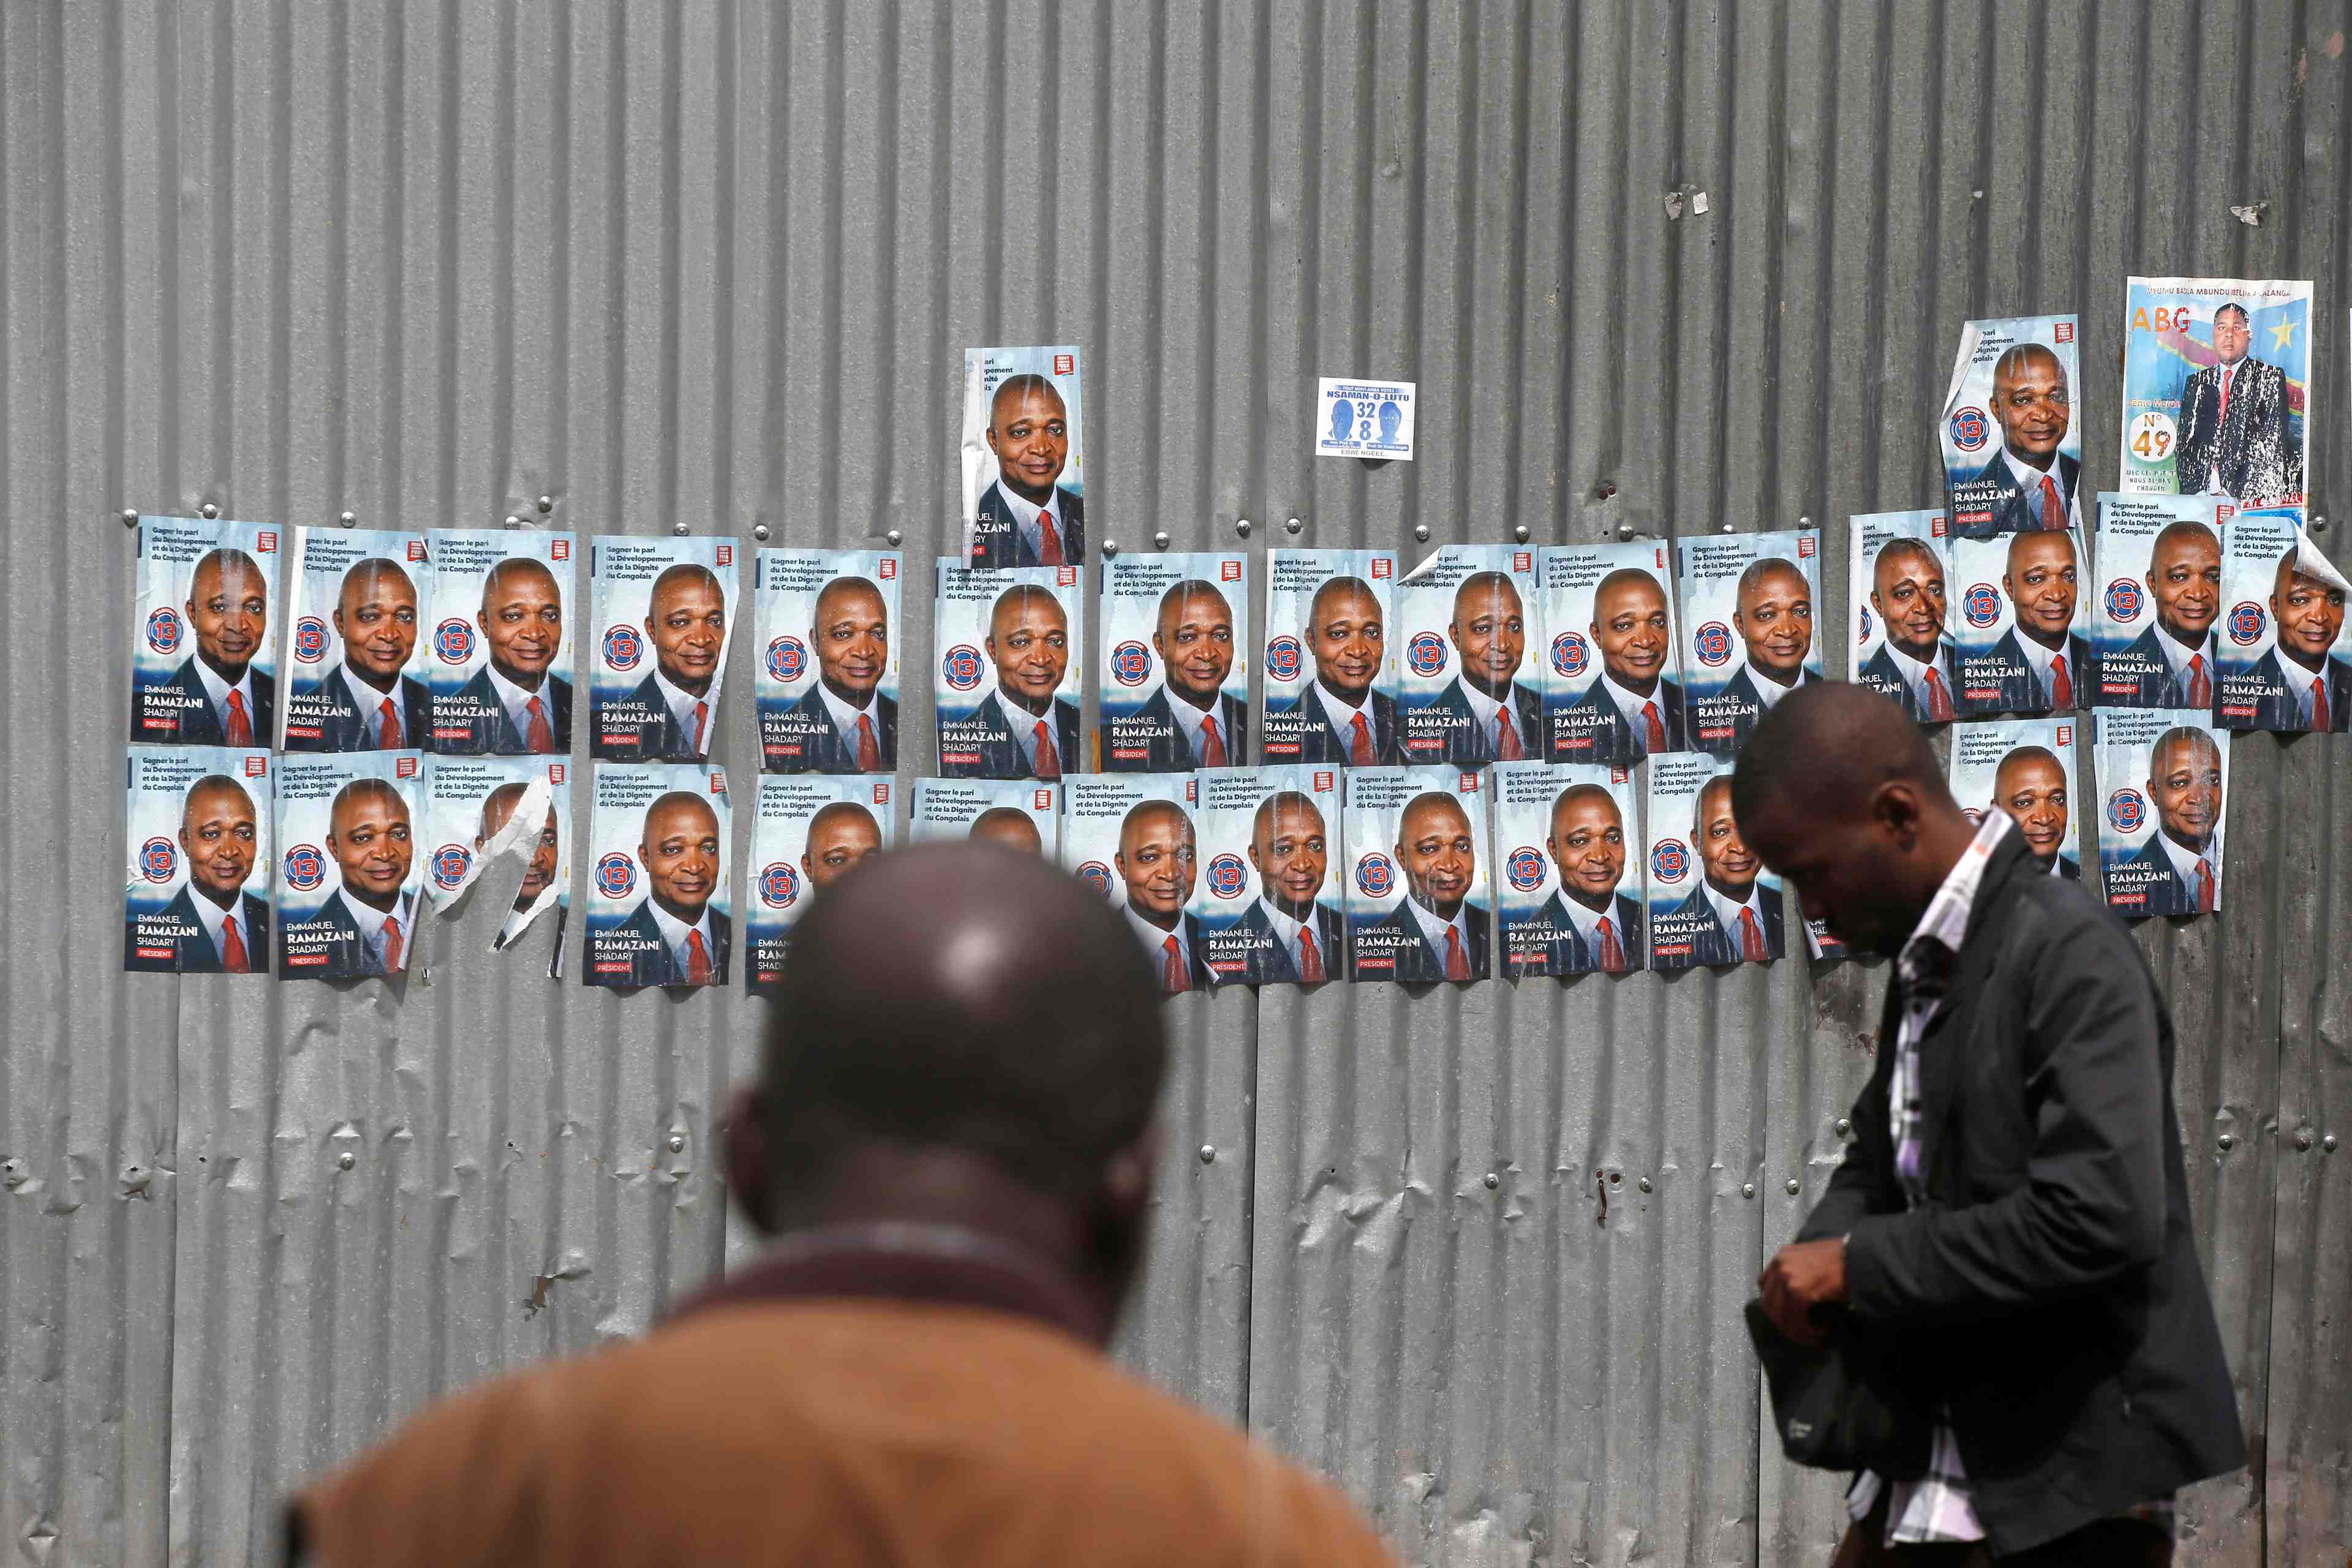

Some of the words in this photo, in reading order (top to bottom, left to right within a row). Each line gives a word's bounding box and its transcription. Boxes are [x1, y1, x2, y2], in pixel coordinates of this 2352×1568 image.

[2132, 306, 2191, 333] ABG
[1327, 391, 1409, 401] NSAMAN-O-LUTU
[1357, 401, 1376, 418] 32
[2144, 415, 2162, 427] N°
[1360, 420, 1371, 440] 8
[1960, 420, 1981, 438] 13
[2133, 430, 2171, 457] 49
[1954, 480, 1997, 490] EMMANUEL
[1956, 490, 2015, 502] RAMAZANI
[1956, 503, 1991, 511] SHADARY
[2112, 502, 2136, 510] Gagner
[2120, 527, 2154, 536] Congolais
[1972, 597, 1994, 614] 13
[2114, 591, 2135, 609] 13
[2237, 615, 2258, 632] 13
[156, 622, 175, 640] 13
[298, 630, 321, 649] 13
[444, 632, 467, 650] 13
[1704, 635, 1725, 652] 13
[612, 639, 634, 657] 13
[776, 650, 798, 668] 13
[1275, 650, 1296, 667] 13
[1417, 646, 1439, 663] 13
[1560, 646, 1581, 663] 13
[2103, 652, 2147, 662] EMMANUEL
[953, 658, 975, 676] 13
[1121, 655, 1144, 672] 13
[2103, 662, 2163, 674] RAMAZANI
[1966, 668, 2024, 677] RAMAZANI
[2103, 673, 2139, 683] SHADARY
[2223, 674, 2266, 684] EMMANUEL
[145, 685, 186, 695] EMMANUEL
[2223, 684, 2283, 697] RAMAZANI
[145, 696, 202, 709] RAMAZANI
[433, 696, 480, 705] EMMANUEL
[1698, 696, 1741, 705] EMMANUEL
[2222, 696, 2258, 706] SHADARY
[433, 706, 498, 718] RAMAZANI
[602, 702, 648, 711] EMMANUEL
[1554, 707, 1598, 716] EMMANUEL
[1699, 705, 1758, 717] RAMAZANI
[144, 707, 178, 718] SHADARY
[603, 712, 666, 723] RAMAZANI
[765, 712, 811, 722] EMMANUEL
[432, 718, 472, 728] SHADARY
[1113, 717, 1158, 725] EMMANUEL
[1409, 717, 1470, 728] RAMAZANI
[1555, 715, 1616, 728] RAMAZANI
[1699, 718, 1735, 727] SHADARY
[602, 724, 640, 733] SHADARY
[765, 723, 828, 734] RAMAZANI
[1113, 727, 1175, 737] RAMAZANI
[1267, 722, 1325, 733] RAMAZANI
[1408, 729, 1446, 737] SHADARY
[1555, 728, 1592, 737] SHADARY
[764, 734, 802, 744] SHADARY
[943, 731, 1007, 742] RAMAZANI
[1266, 733, 1302, 742] SHADARY
[943, 743, 981, 752] SHADARY
[1112, 739, 1150, 747] SHADARY
[446, 791, 481, 800] Congolais
[926, 788, 950, 797] Gagner
[2117, 802, 2138, 819] 13
[149, 851, 170, 869] 13
[1660, 852, 1681, 870] 13
[294, 858, 317, 876] 13
[442, 859, 464, 876] 13
[1517, 860, 1537, 878] 13
[605, 867, 627, 884] 13
[1216, 867, 1238, 885] 13
[1366, 867, 1387, 883] 13
[2110, 872, 2170, 883] RAMAZANI
[769, 876, 791, 894] 13
[138, 914, 181, 924] EMMANUEL
[1654, 913, 1698, 922] EMMANUEL
[138, 925, 198, 937] RAMAZANI
[287, 922, 335, 931] EMMANUEL
[1655, 922, 1715, 934] RAMAZANI
[288, 931, 354, 943] RAMAZANI
[596, 930, 641, 938] EMMANUEL
[1655, 935, 1692, 944] SHADARY
[137, 937, 174, 947] SHADARY
[596, 940, 659, 951] RAMAZANI
[1210, 940, 1272, 950] RAMAZANI
[1357, 937, 1420, 947] RAMAZANI
[288, 944, 328, 954] SHADARY
[595, 952, 633, 961] SHADARY
